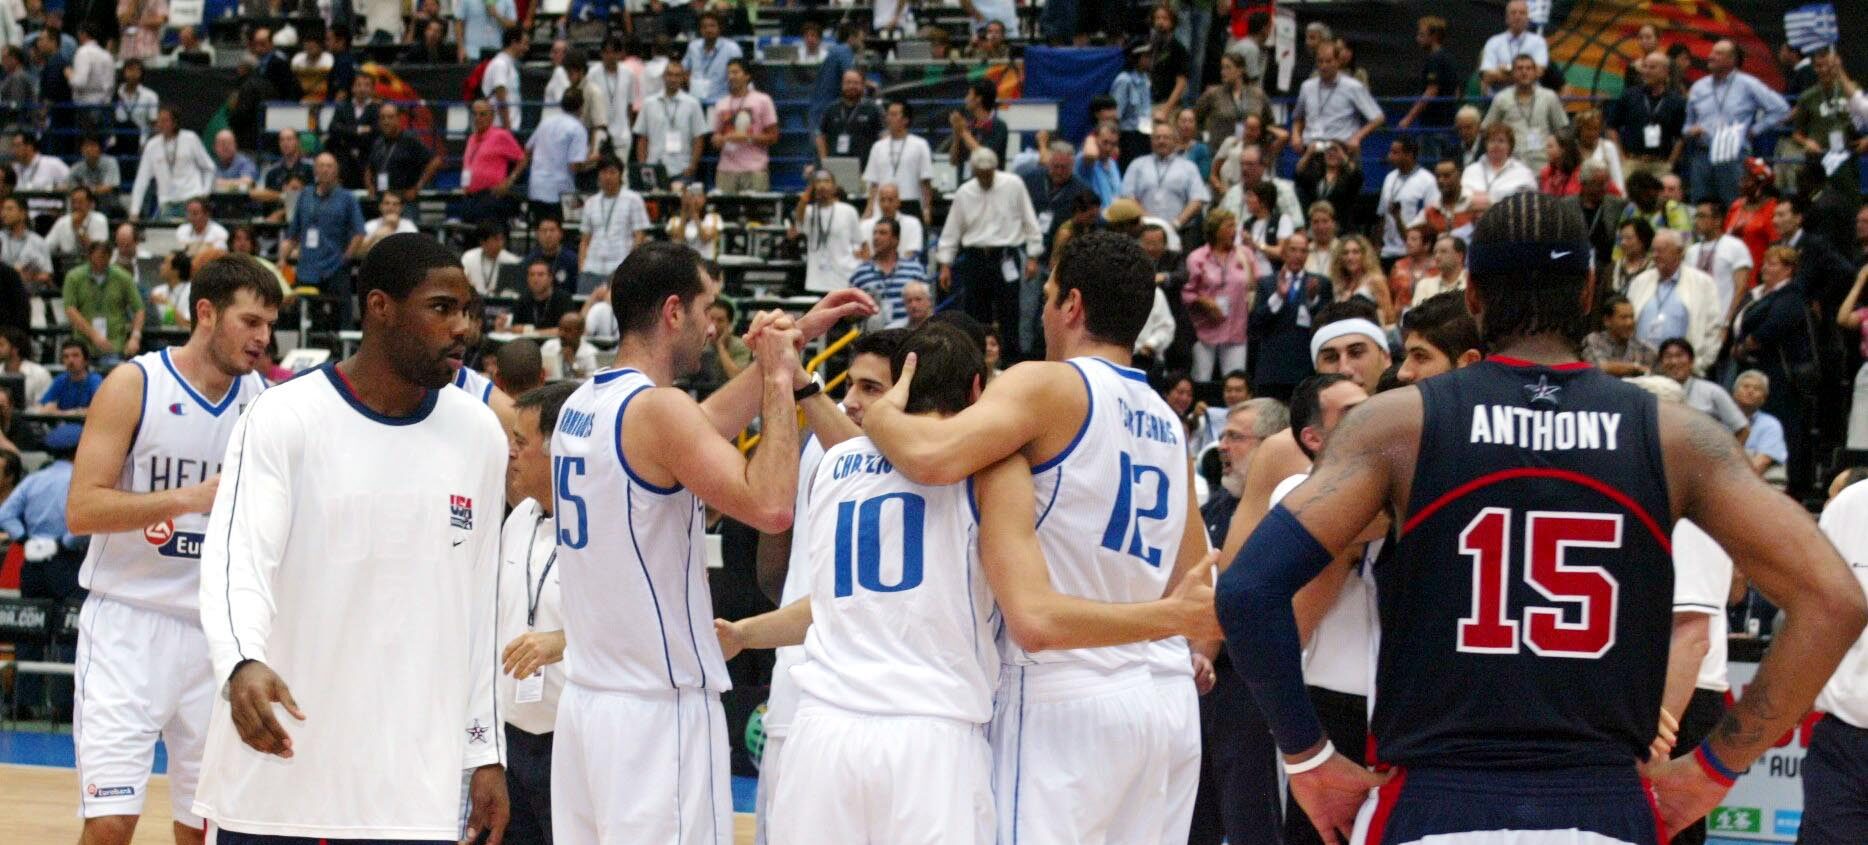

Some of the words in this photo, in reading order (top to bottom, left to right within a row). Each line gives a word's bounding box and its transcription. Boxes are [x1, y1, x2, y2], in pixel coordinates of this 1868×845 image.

[1470, 404, 1622, 451] ANTHONY
[450, 494, 472, 519] USA
[554, 455, 588, 550] 15
[834, 491, 926, 598] 10
[1101, 451, 1170, 568] 12
[1456, 506, 1624, 659] 15
[1770, 755, 1804, 778] AU
